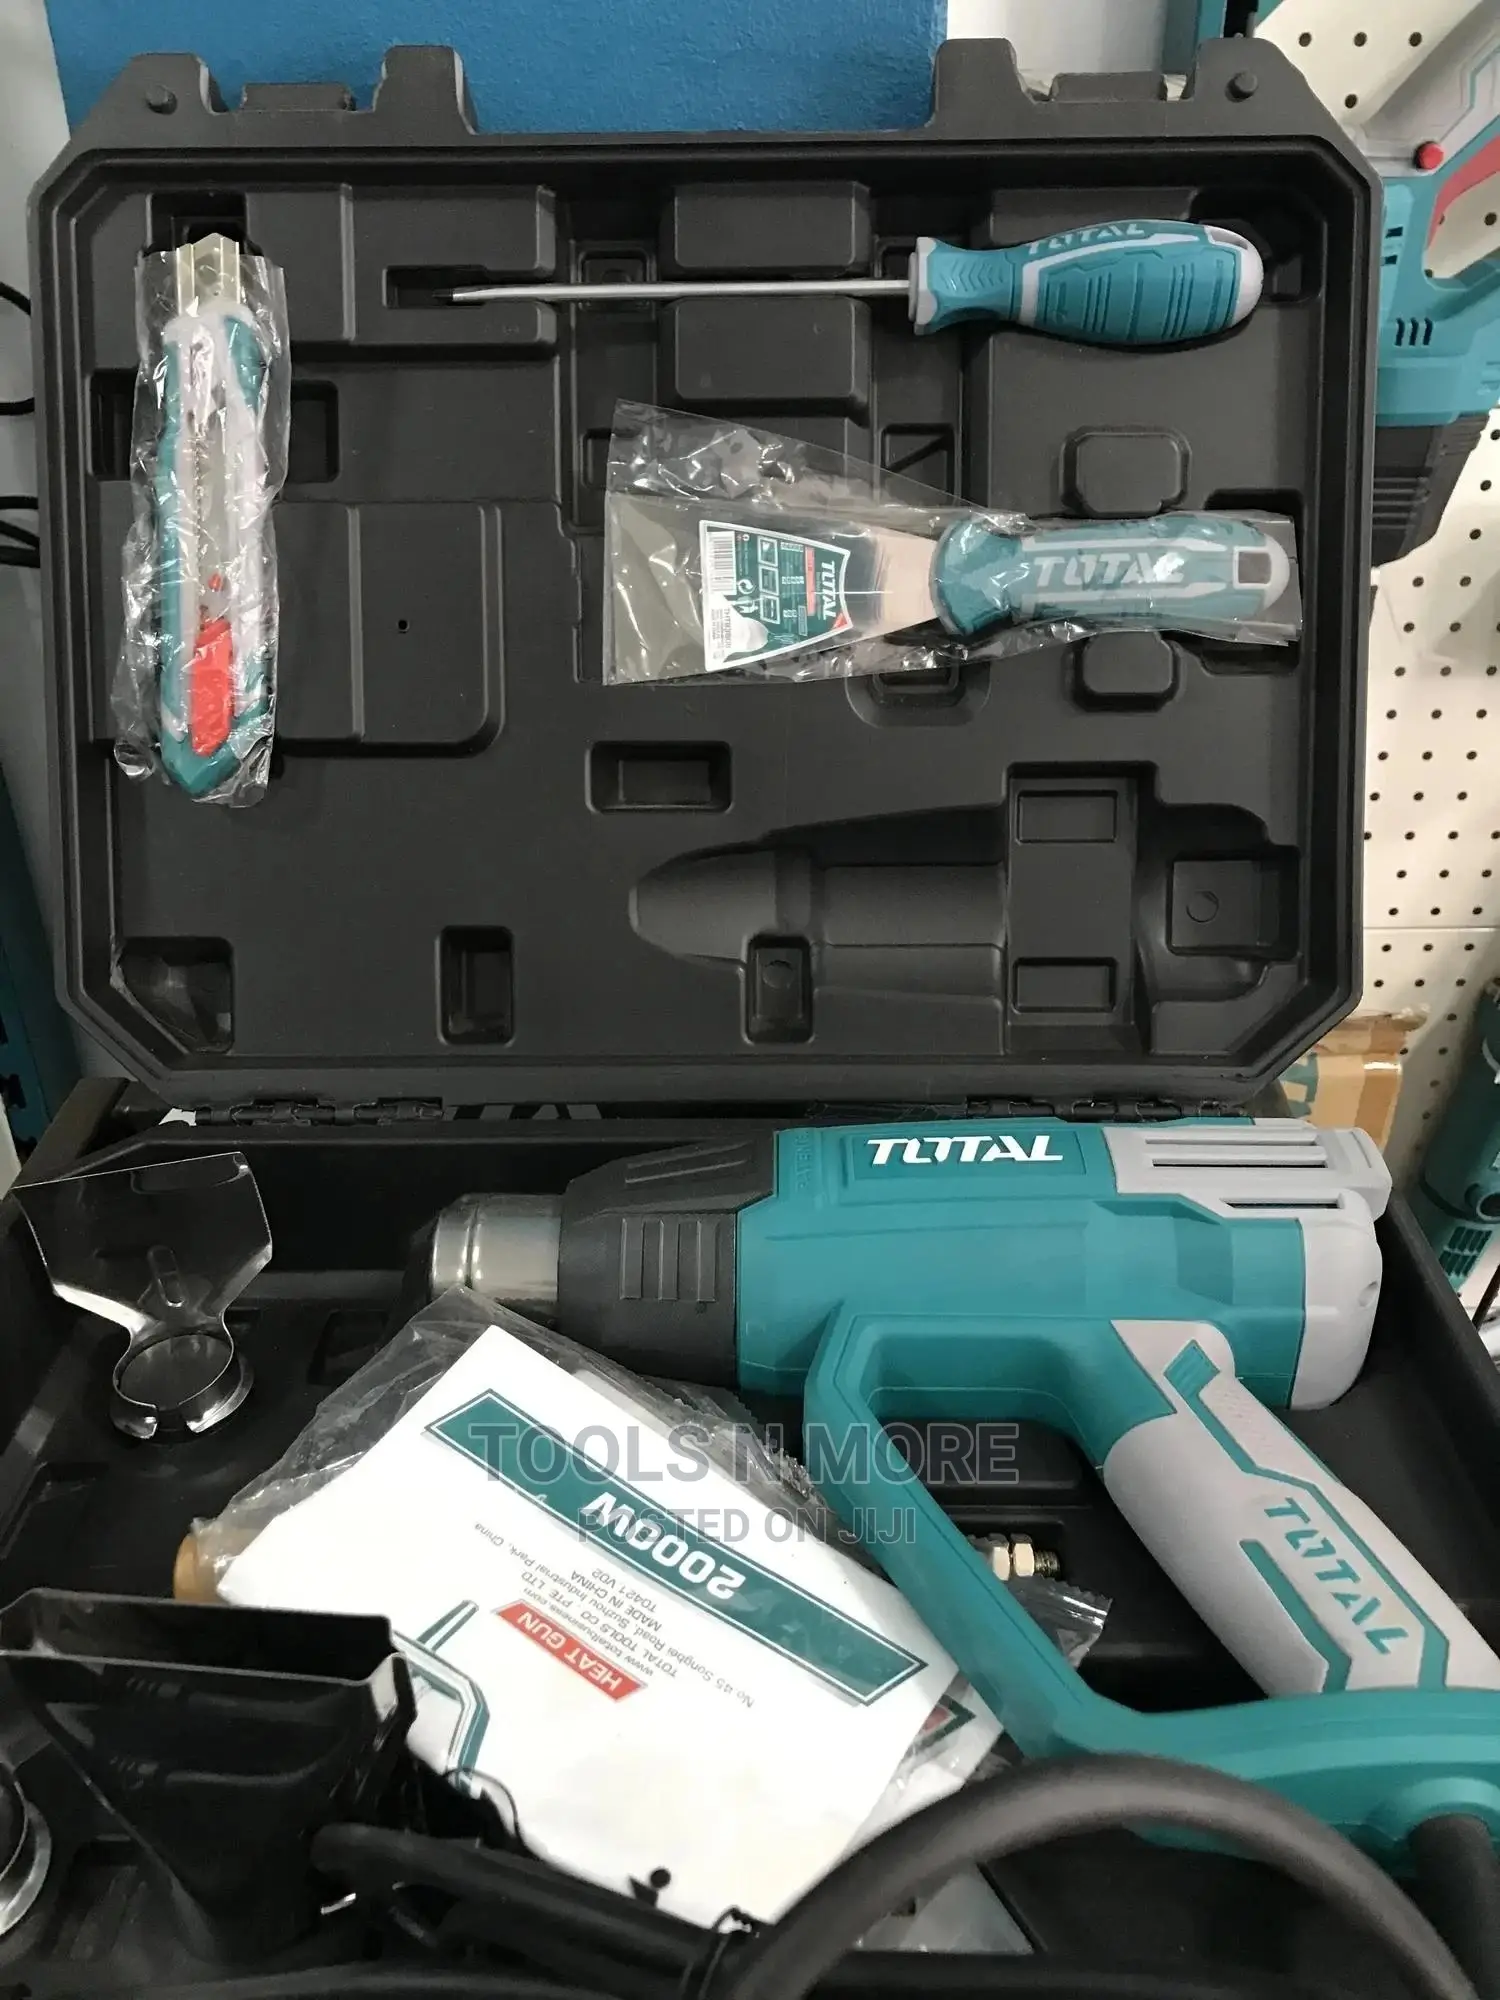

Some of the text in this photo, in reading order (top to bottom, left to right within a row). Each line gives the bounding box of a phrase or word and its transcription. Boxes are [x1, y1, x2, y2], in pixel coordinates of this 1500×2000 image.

[1026, 223, 1145, 255] TOTAL
[1034, 552, 1185, 587] TOTAL
[821, 560, 837, 620] TOTAL
[867, 1135, 1064, 1165] TOTAL
[579, 1491, 747, 1600] 2000W
[535, 1564, 588, 1602] Industrial
[1263, 1497, 1409, 1655] TOTAL
[571, 1570, 662, 1632] MADE IN CHINA
[588, 1598, 630, 1629] Suzhou
[516, 1611, 623, 1692] HEAT GUN
[599, 1623, 638, 1652] TOOLS
[642, 1648, 678, 1678] TOTAL
[667, 1647, 714, 1682] Songbei
